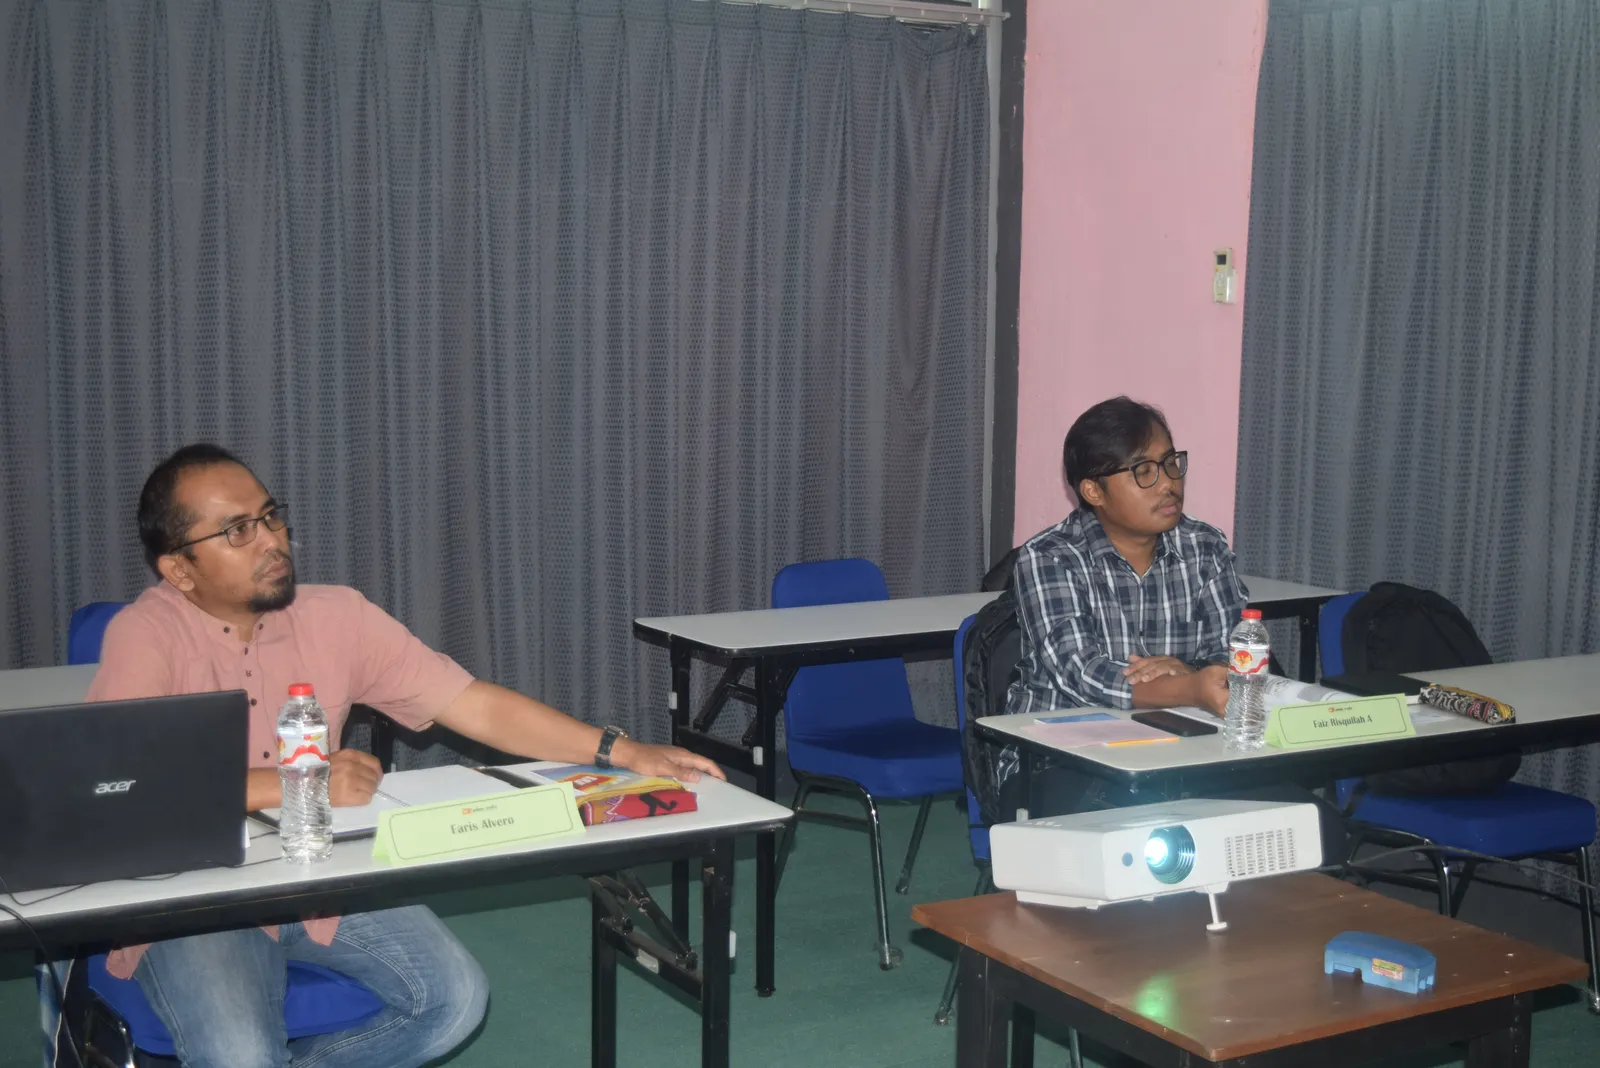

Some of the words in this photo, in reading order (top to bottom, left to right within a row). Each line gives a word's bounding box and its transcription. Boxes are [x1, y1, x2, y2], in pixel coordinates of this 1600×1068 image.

[1313, 719, 1328, 728] Faiz
[1330, 715, 1365, 727] Risqullah
[1366, 714, 1373, 723] A
[95, 779, 137, 794] acer
[450, 821, 479, 835] Faris
[481, 816, 515, 830] Alvero
